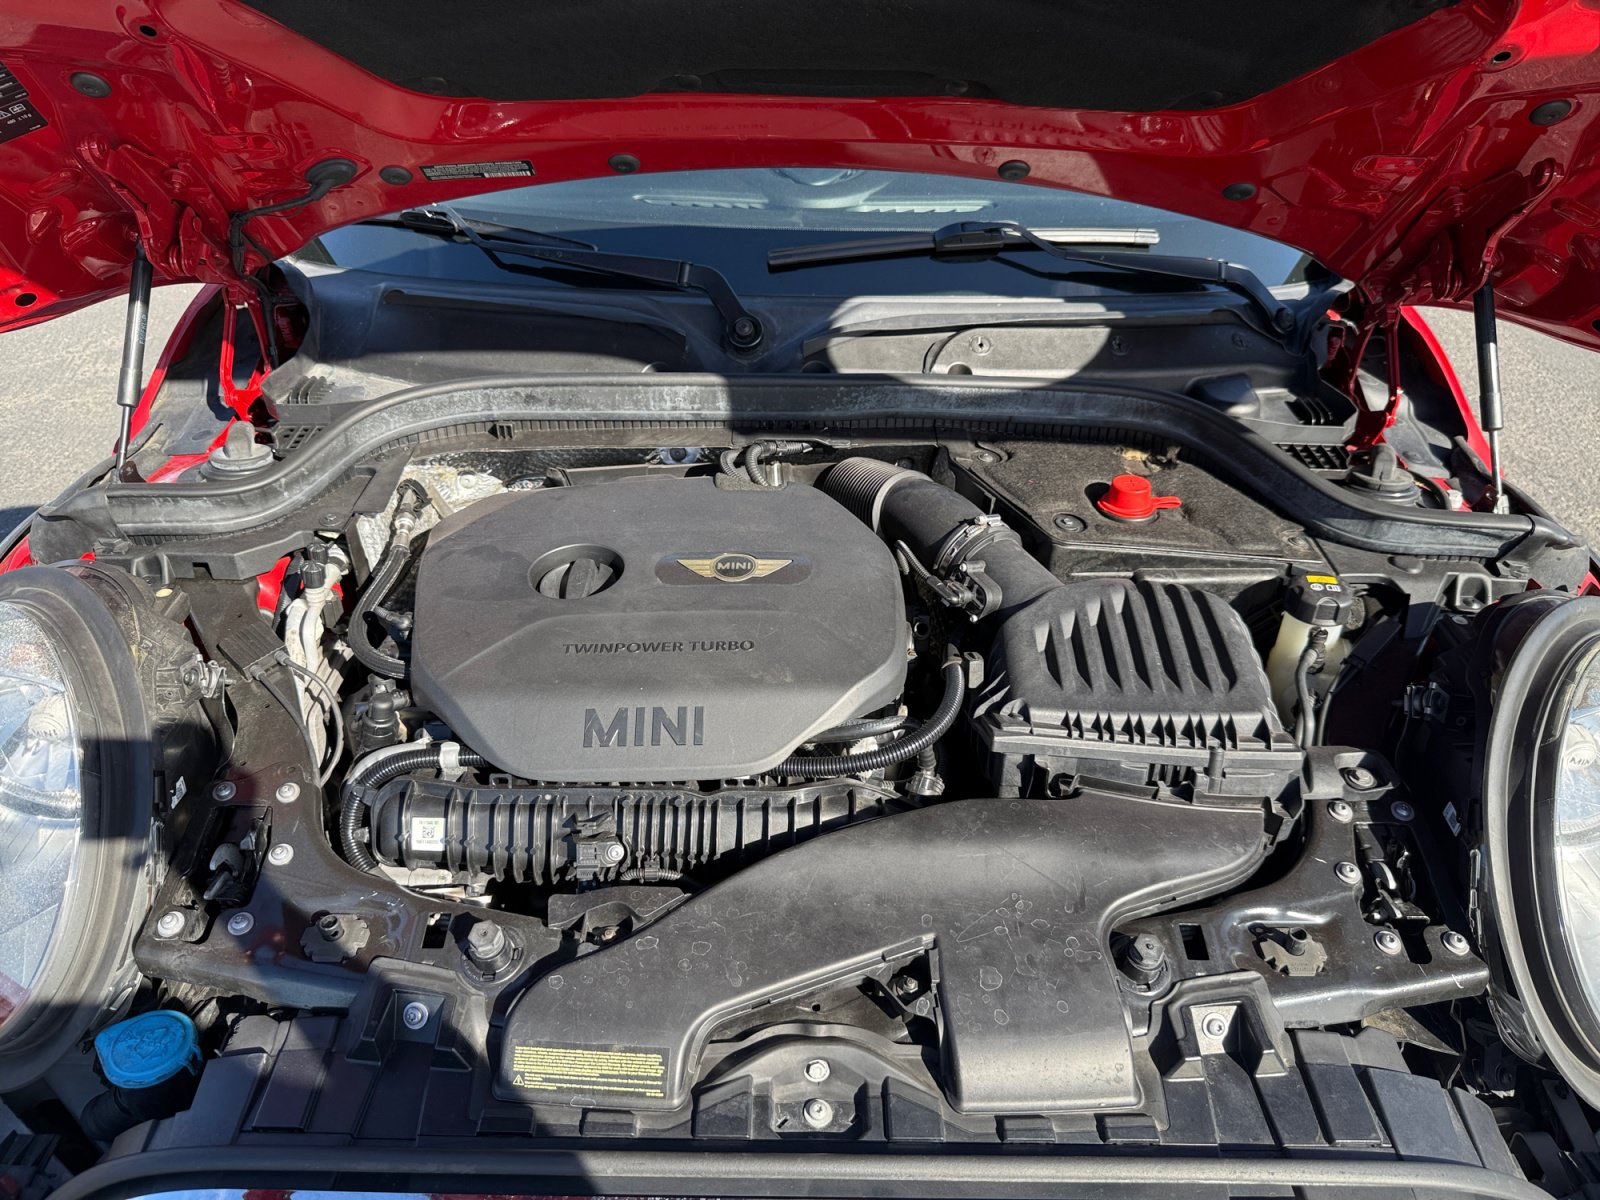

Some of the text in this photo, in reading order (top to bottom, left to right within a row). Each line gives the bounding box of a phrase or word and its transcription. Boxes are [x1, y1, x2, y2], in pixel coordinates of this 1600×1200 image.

[717, 561, 751, 570] MINI
[562, 640, 756, 655] TWINPOWER TURBO
[583, 706, 704, 748] MINI
